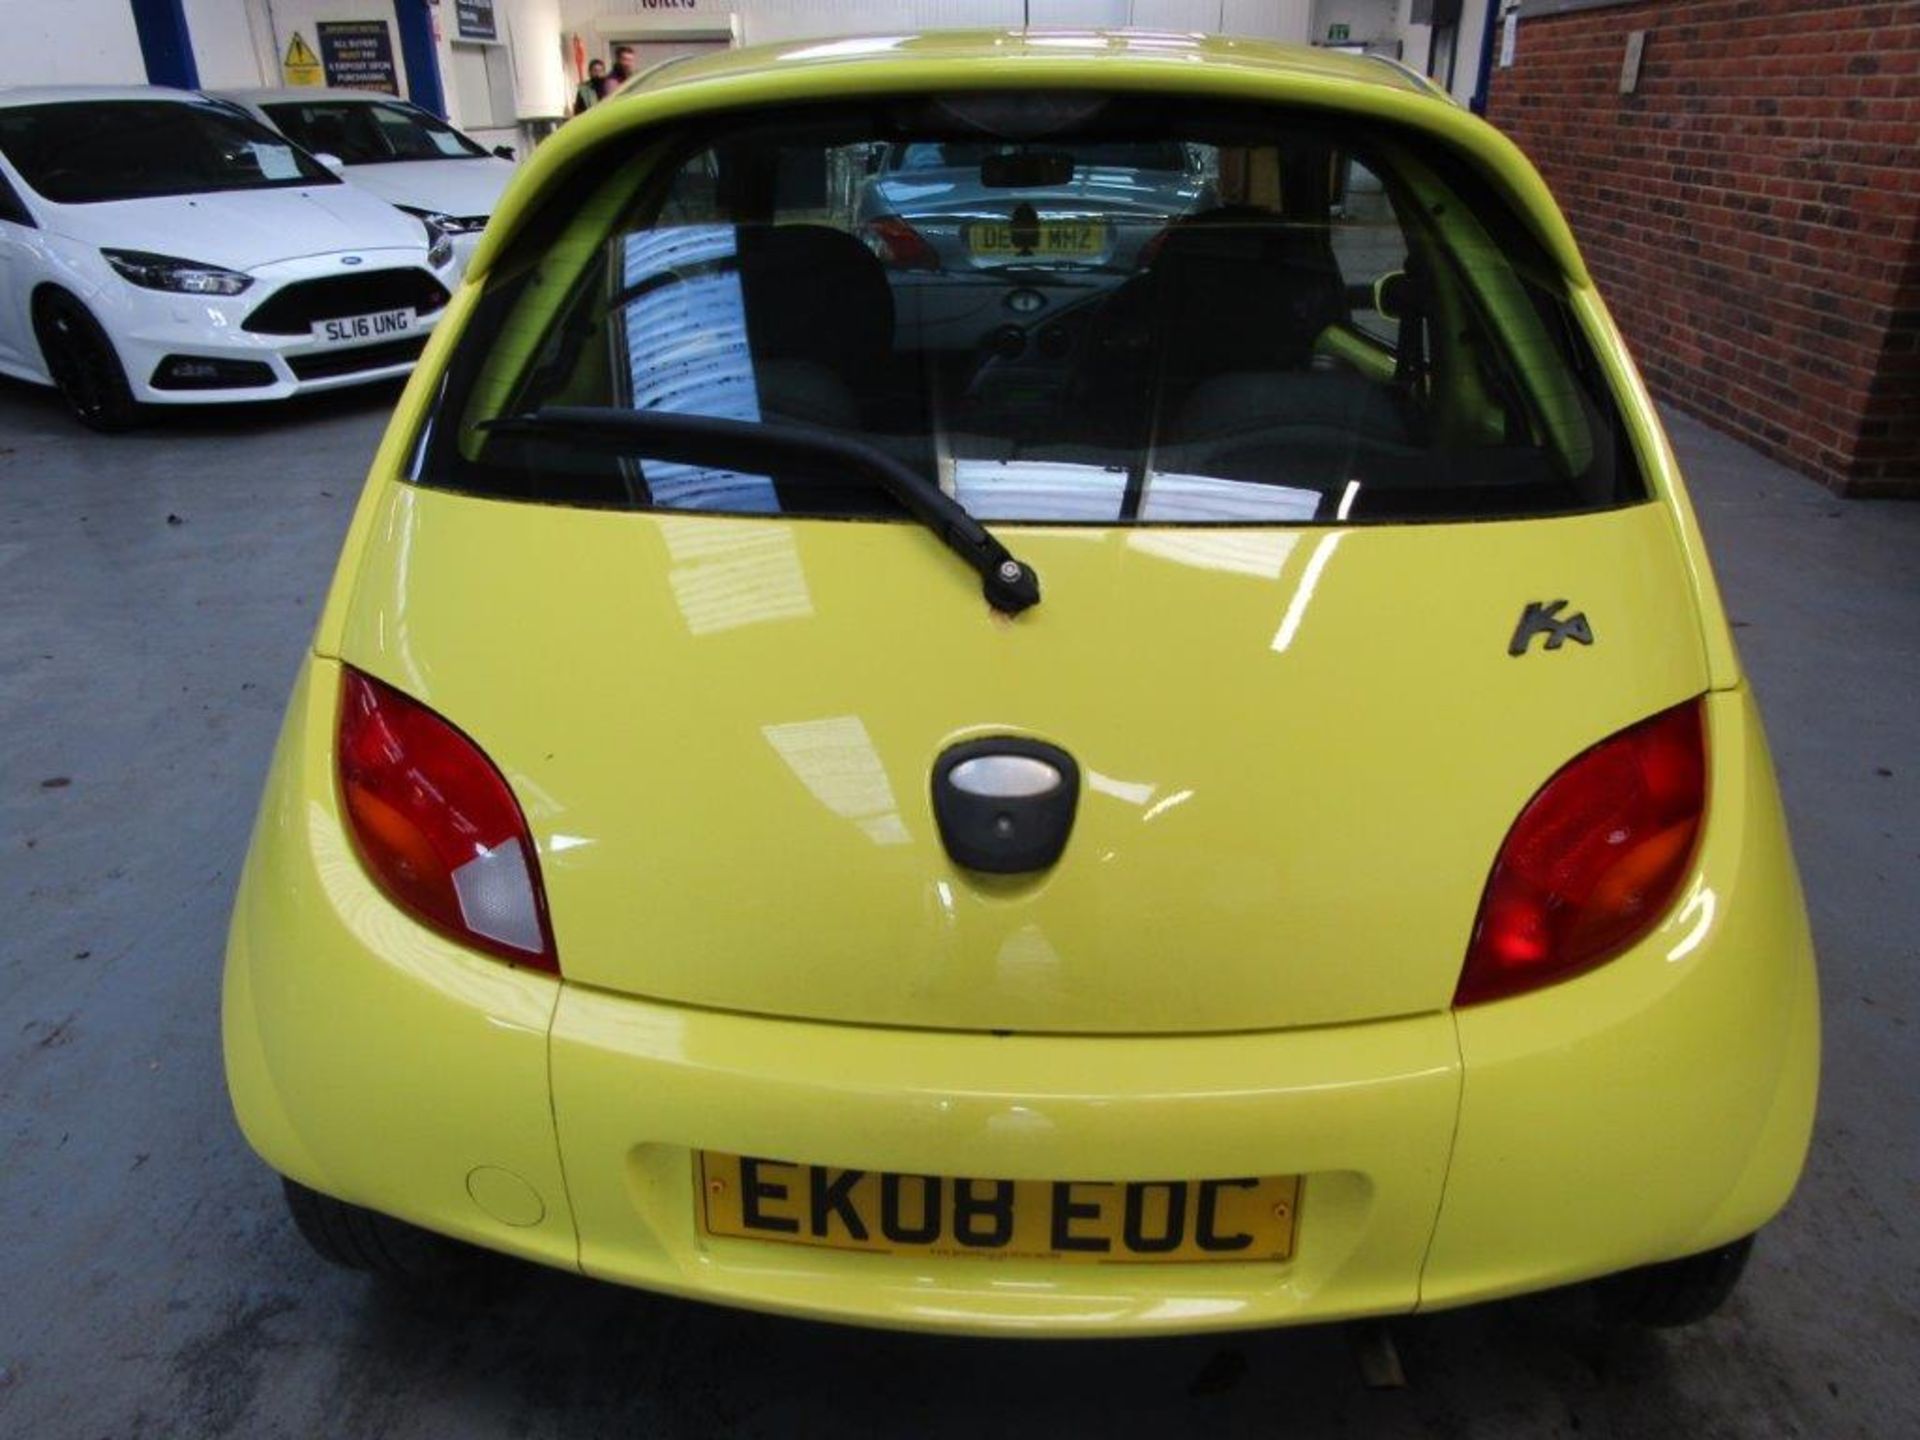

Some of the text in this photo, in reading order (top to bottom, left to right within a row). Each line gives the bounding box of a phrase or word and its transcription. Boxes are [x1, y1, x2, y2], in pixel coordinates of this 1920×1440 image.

[325, 312, 408, 340] SL16 UNG
[740, 1156, 1259, 1253] EK08 EOC
